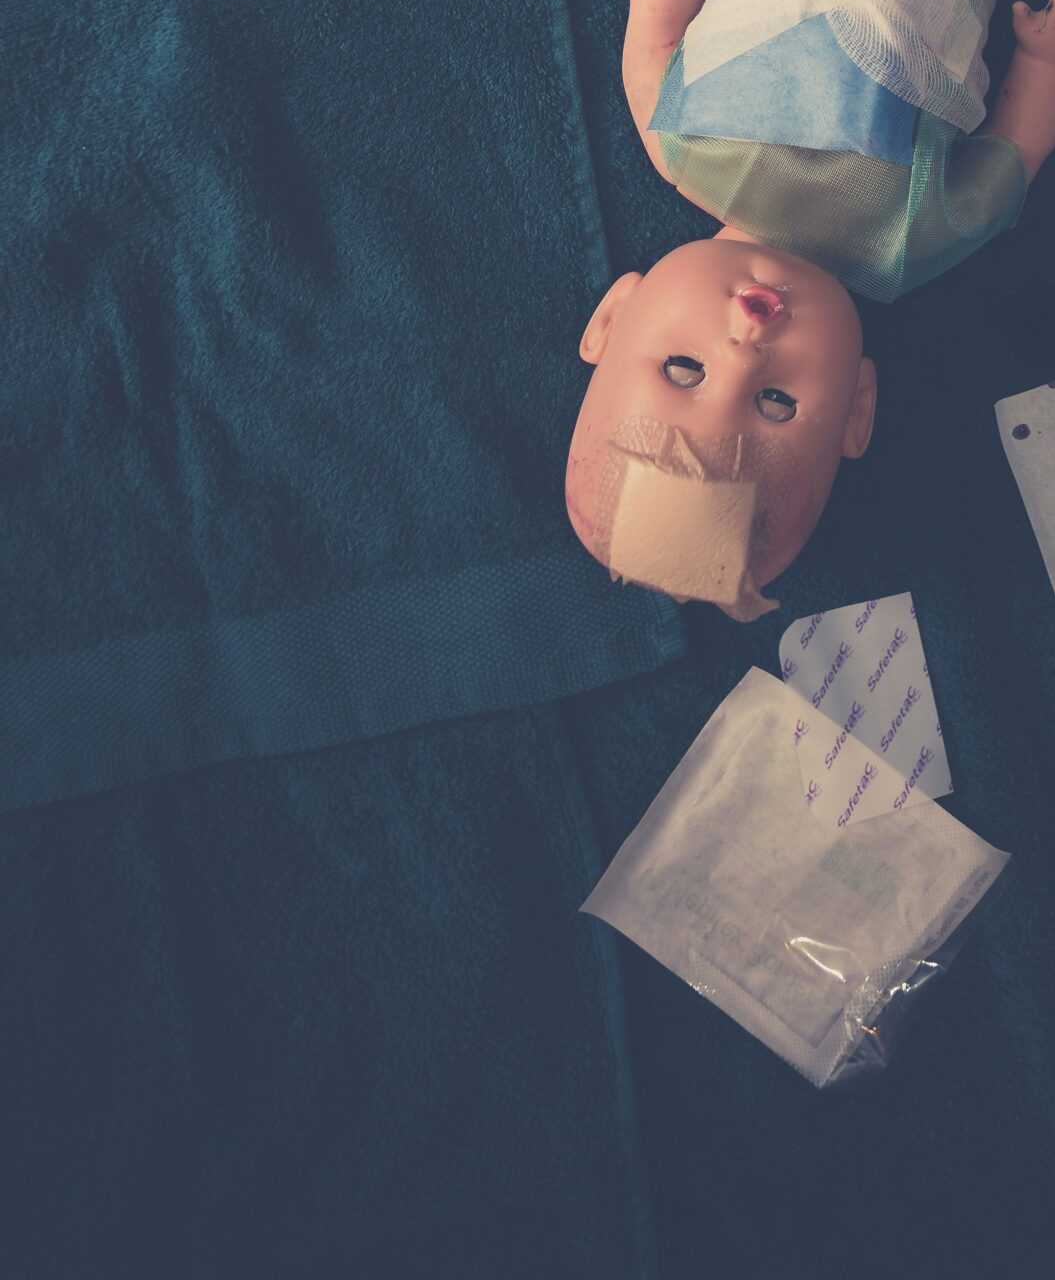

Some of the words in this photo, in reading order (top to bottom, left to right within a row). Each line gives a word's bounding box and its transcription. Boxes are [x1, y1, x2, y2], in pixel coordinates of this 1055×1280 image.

[812, 641, 854, 709] Safetac
[867, 627, 910, 693] Safetac
[825, 701, 867, 770] Safetac
[880, 685, 922, 753] Safetac
[837, 761, 879, 828] Safetac
[893, 745, 935, 810] Safetac
